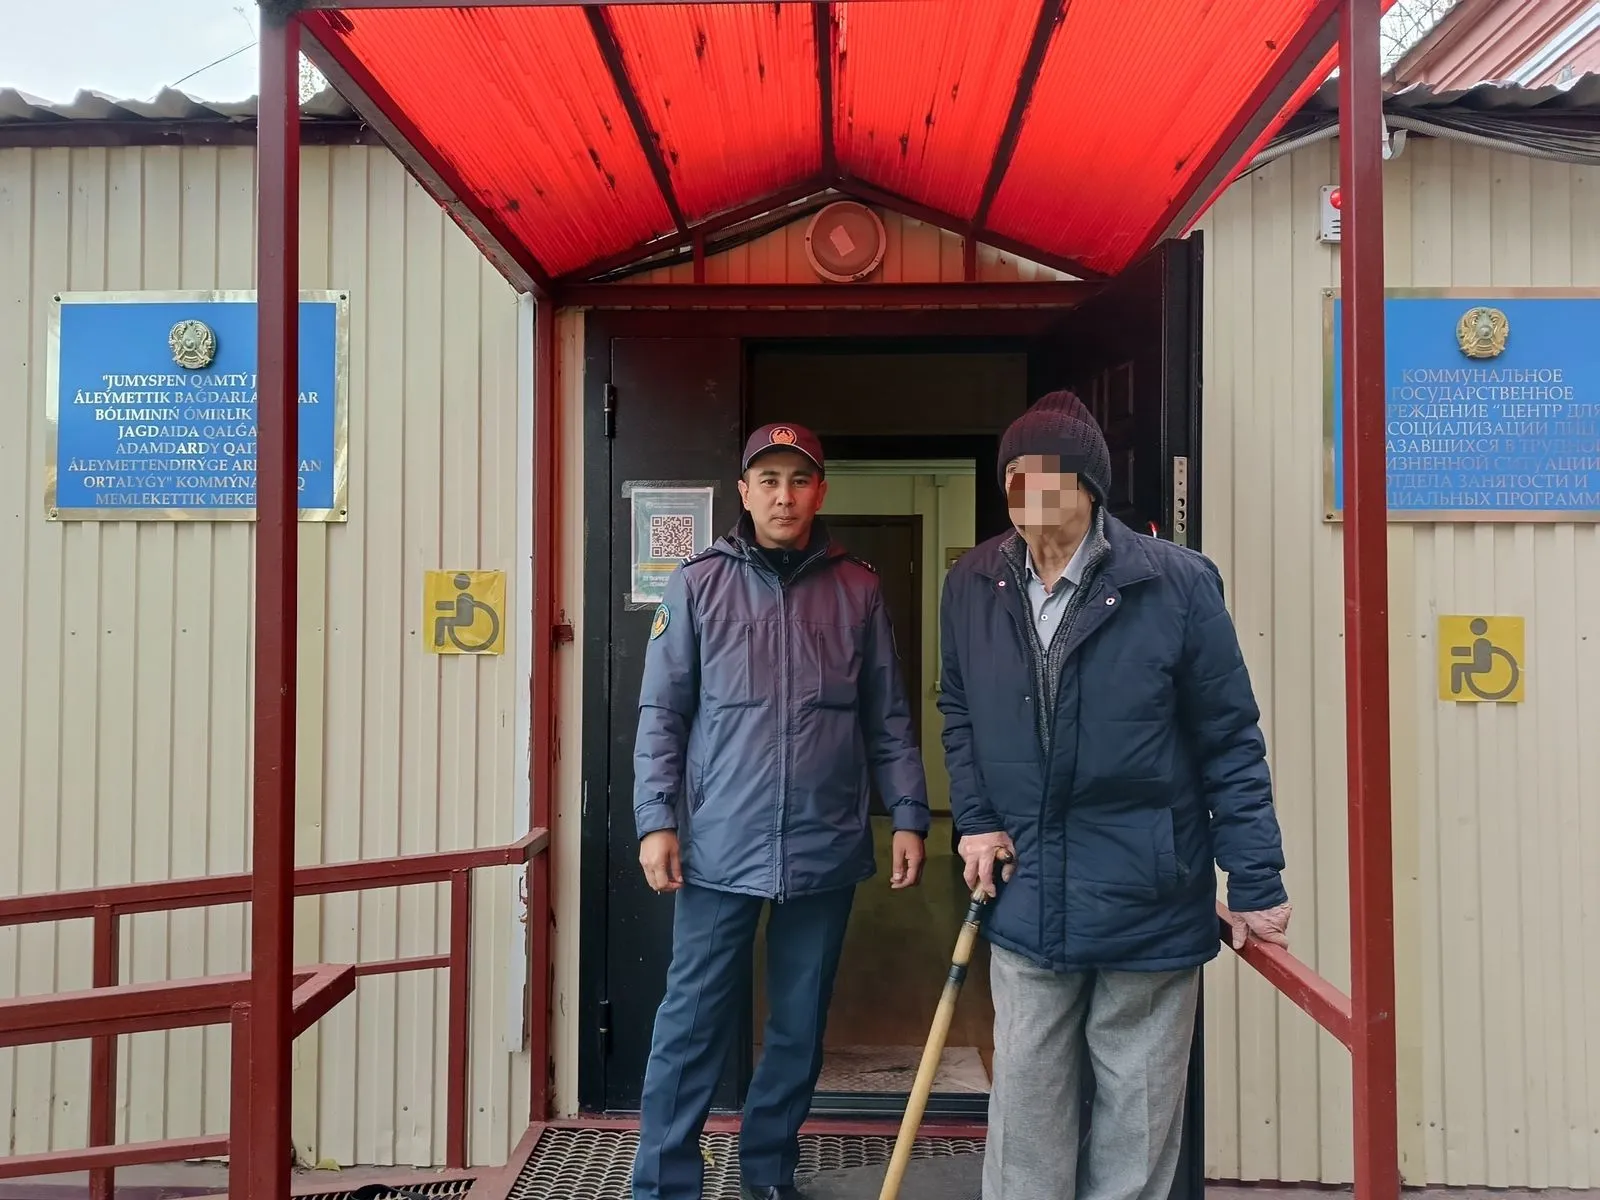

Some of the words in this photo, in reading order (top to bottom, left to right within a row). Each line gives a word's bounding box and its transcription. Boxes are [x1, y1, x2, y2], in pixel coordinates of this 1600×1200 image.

[102, 374, 186, 390] "JUMYSPEN
[191, 371, 248, 389] QAMTÝ
[1402, 368, 1563, 386] КОММУНАЛЬНОЕ
[73, 388, 170, 404] ÁLEÝMETTIK
[175, 388, 319, 404] BAǴDARLAAR
[1392, 386, 1574, 403] ГОСУДАРСТВЕННОЕ
[95, 405, 180, 421] BÓLIMINIŃ
[183, 406, 253, 421] ÓMIRLIK
[1387, 404, 1489, 420] РЕЖДЕНИЕ
[117, 425, 200, 440] JAGDAIDA
[203, 422, 258, 439] QALǴA
[1386, 421, 1548, 438] СОЦИАЛИЗАЦИИ
[116, 442, 219, 455] ADAMDARDY
[223, 442, 257, 456] QAI
[1386, 439, 1499, 453] АЗАВШИХСЯ
[1386, 455, 1489, 471] ИЗНЕННОЙ
[1458, 474, 1569, 488] ЗАНЯТОСТИ
[1574, 474, 1589, 488] И
[95, 493, 205, 505] MEMLEKETTIK
[210, 493, 257, 505] MEKE
[1387, 491, 1491, 507] ЦИАЛЬНЫХ
[1496, 491, 1600, 506] ПРОГРАММ
